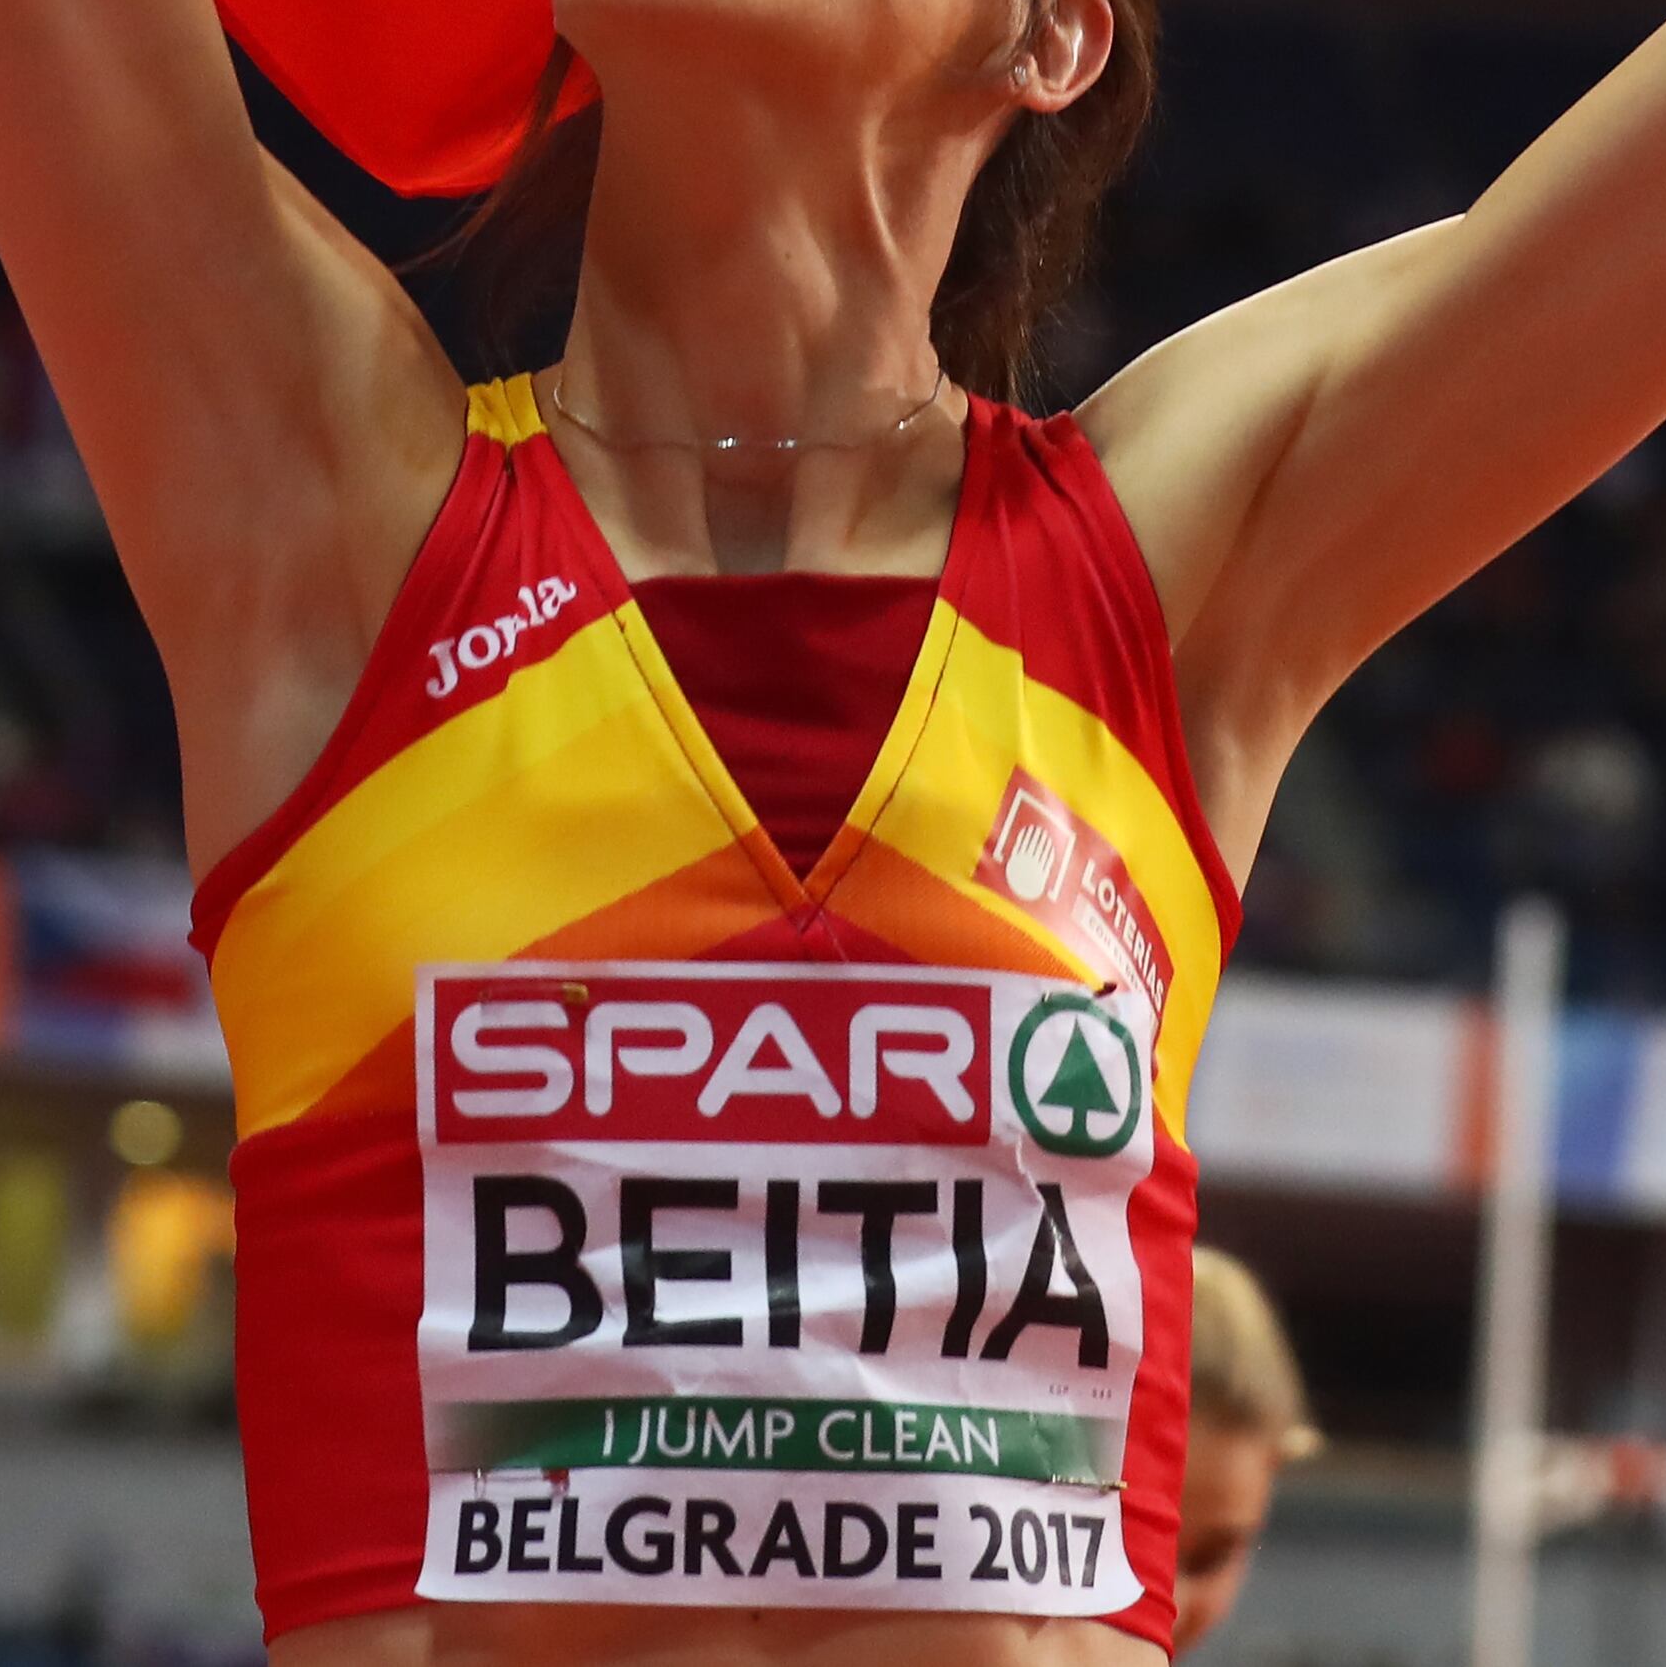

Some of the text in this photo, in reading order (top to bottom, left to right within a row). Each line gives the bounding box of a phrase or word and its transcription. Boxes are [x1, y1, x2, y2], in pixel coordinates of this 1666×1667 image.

[451, 1002, 975, 1122] SPAR
[467, 1174, 1110, 1370] BEITIA
[603, 1408, 999, 1466] I JUMP CLEAN
[454, 1496, 1106, 1588] BELGRADE 2017
